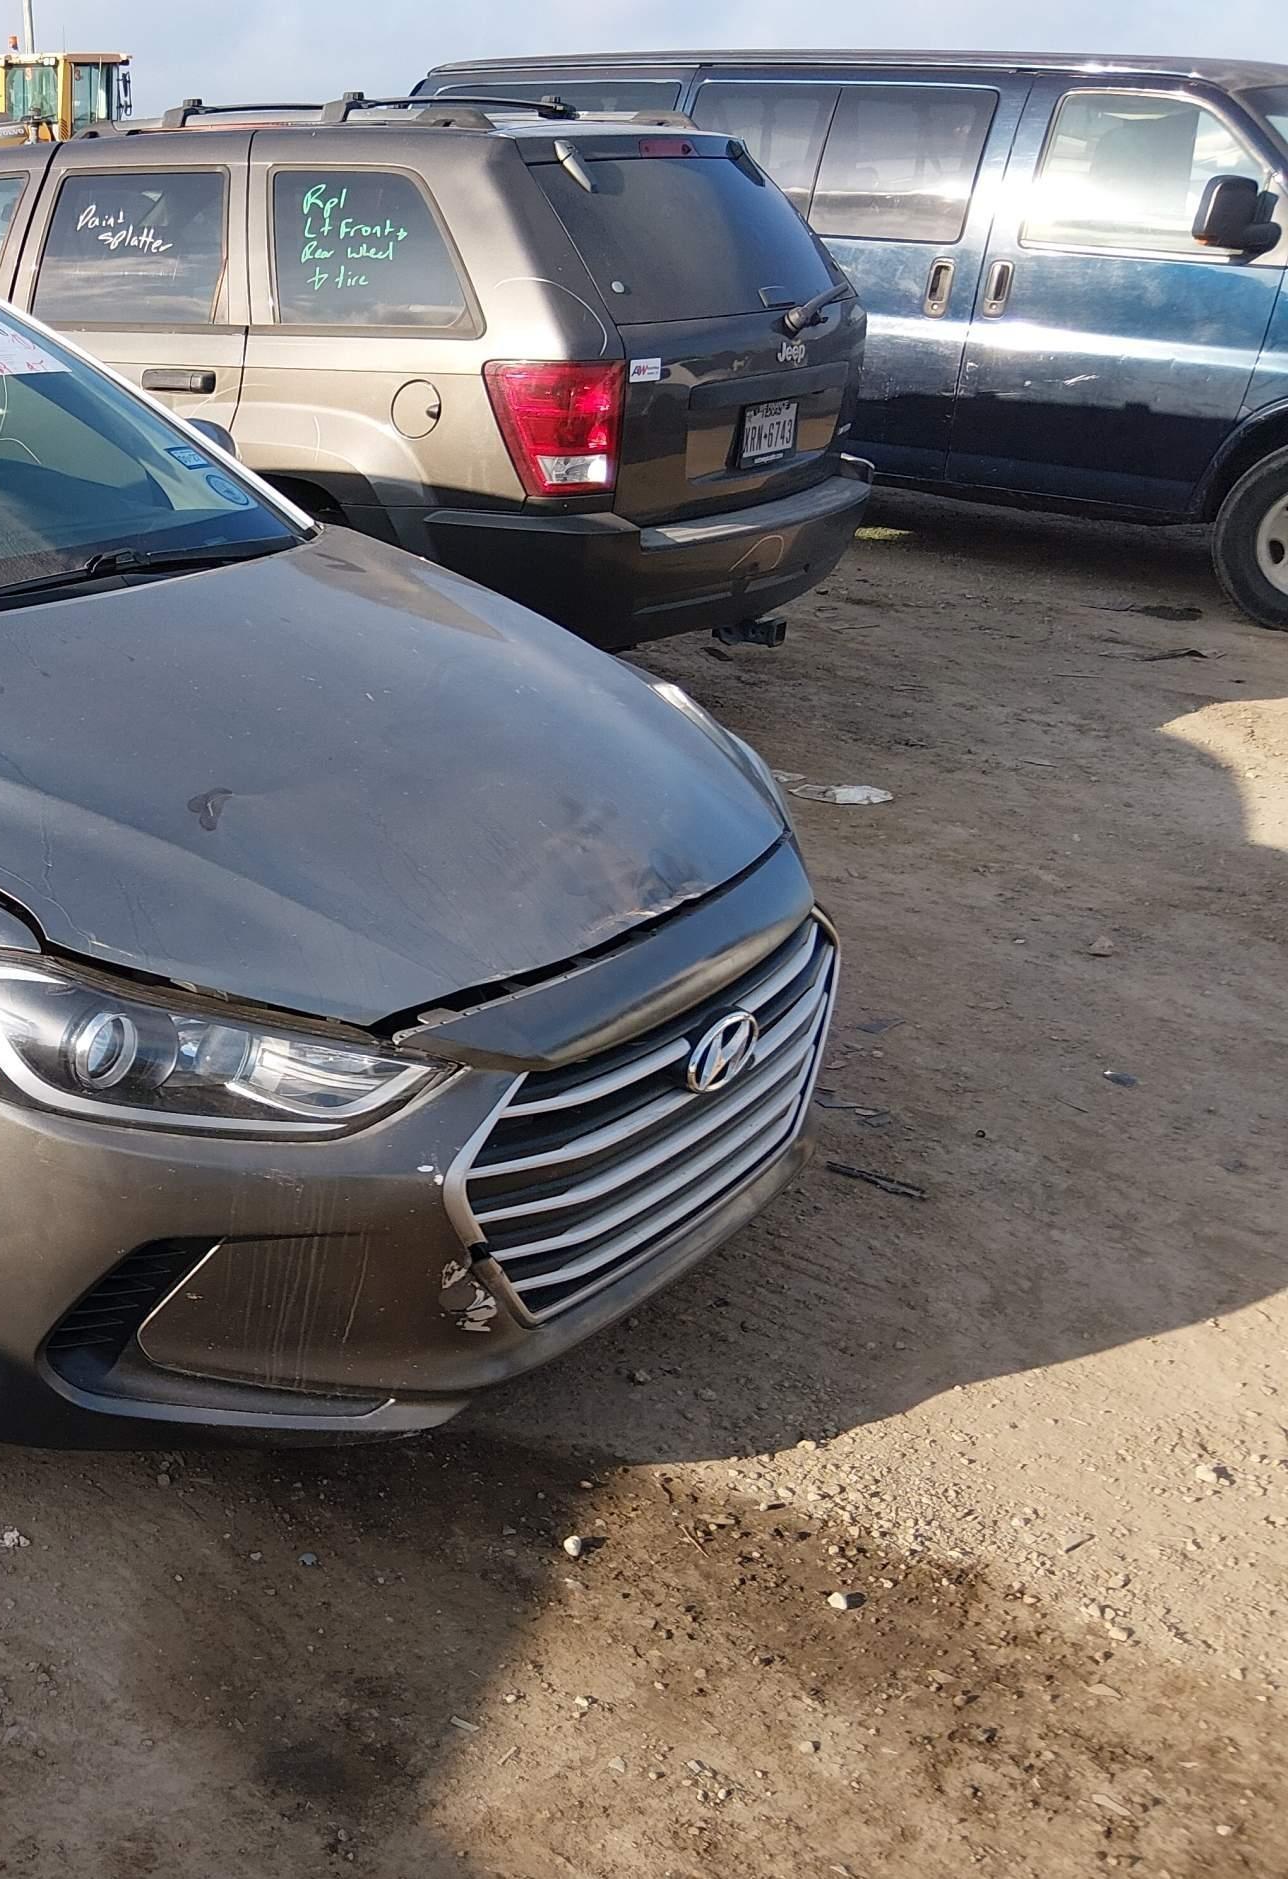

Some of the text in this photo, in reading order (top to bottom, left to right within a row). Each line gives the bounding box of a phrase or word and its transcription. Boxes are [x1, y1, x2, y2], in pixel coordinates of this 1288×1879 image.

[76, 204, 126, 231] Paint
[339, 219, 394, 239] Front
[334, 265, 369, 288] tire
[777, 342, 806, 363] Jeep
